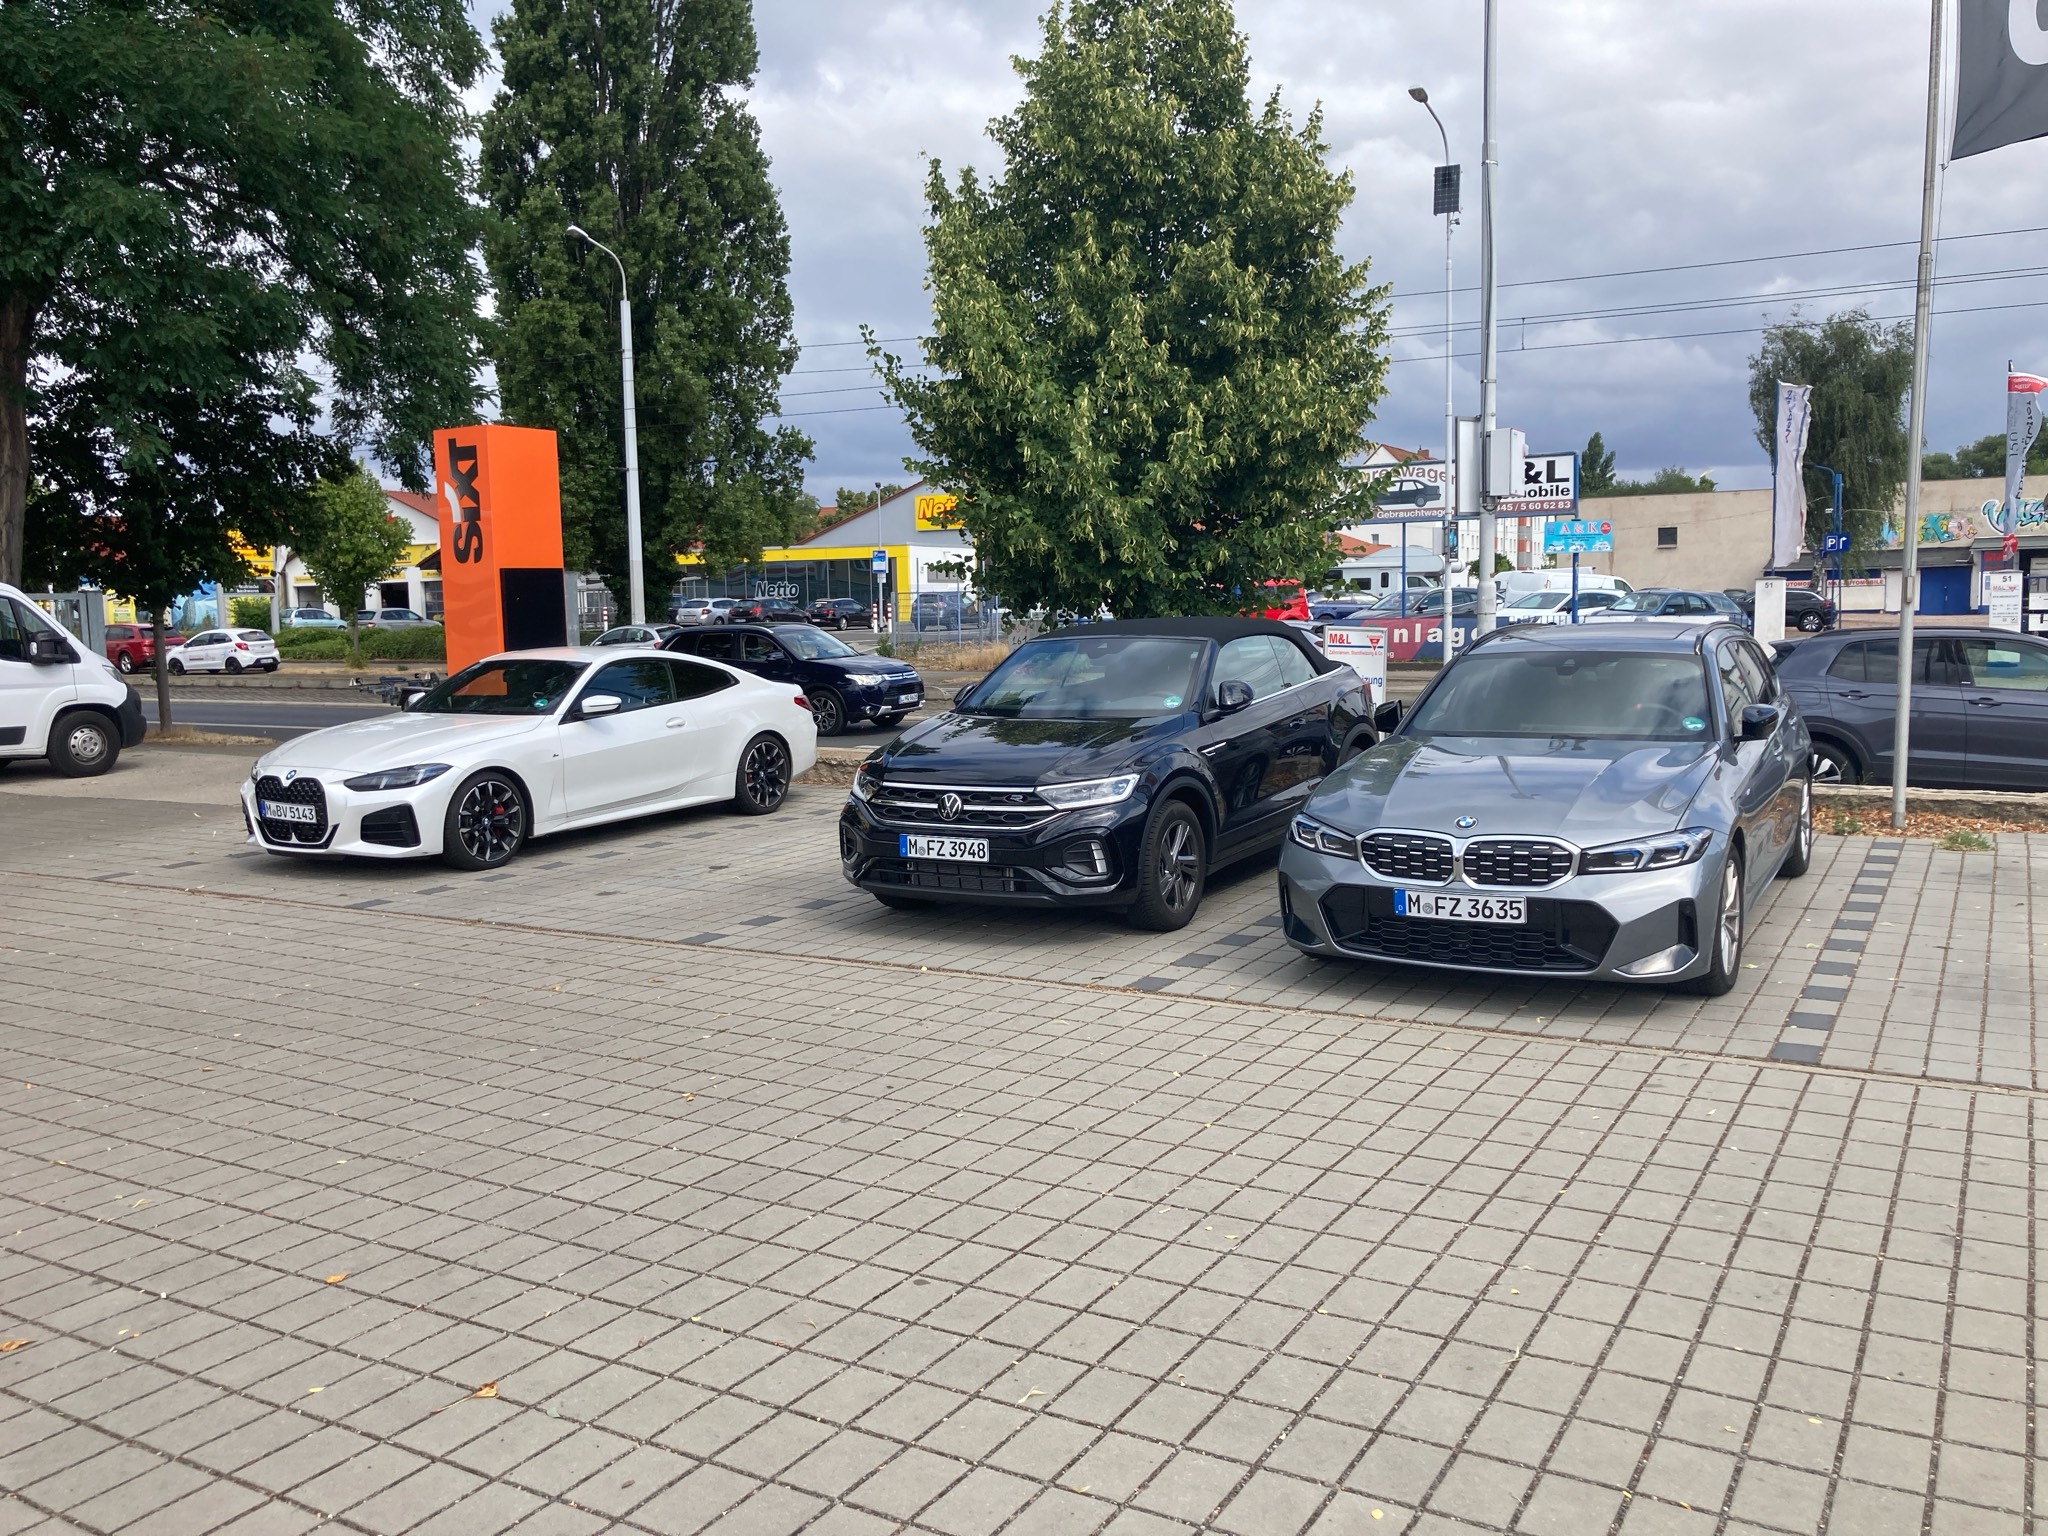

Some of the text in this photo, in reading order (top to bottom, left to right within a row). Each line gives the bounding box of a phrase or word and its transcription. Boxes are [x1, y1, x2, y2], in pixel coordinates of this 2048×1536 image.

[1557, 500, 1571, 509] 83
[1828, 538, 1836, 549] P
[2002, 575, 2012, 583] 51
[755, 581, 800, 598] Netto
[1328, 633, 1352, 645] M&L
[289, 807, 314, 820] 5143
[927, 840, 946, 857] FZ
[950, 841, 986, 859] 3948
[1435, 897, 1462, 917] FZ
[1467, 899, 1522, 920] 3635
